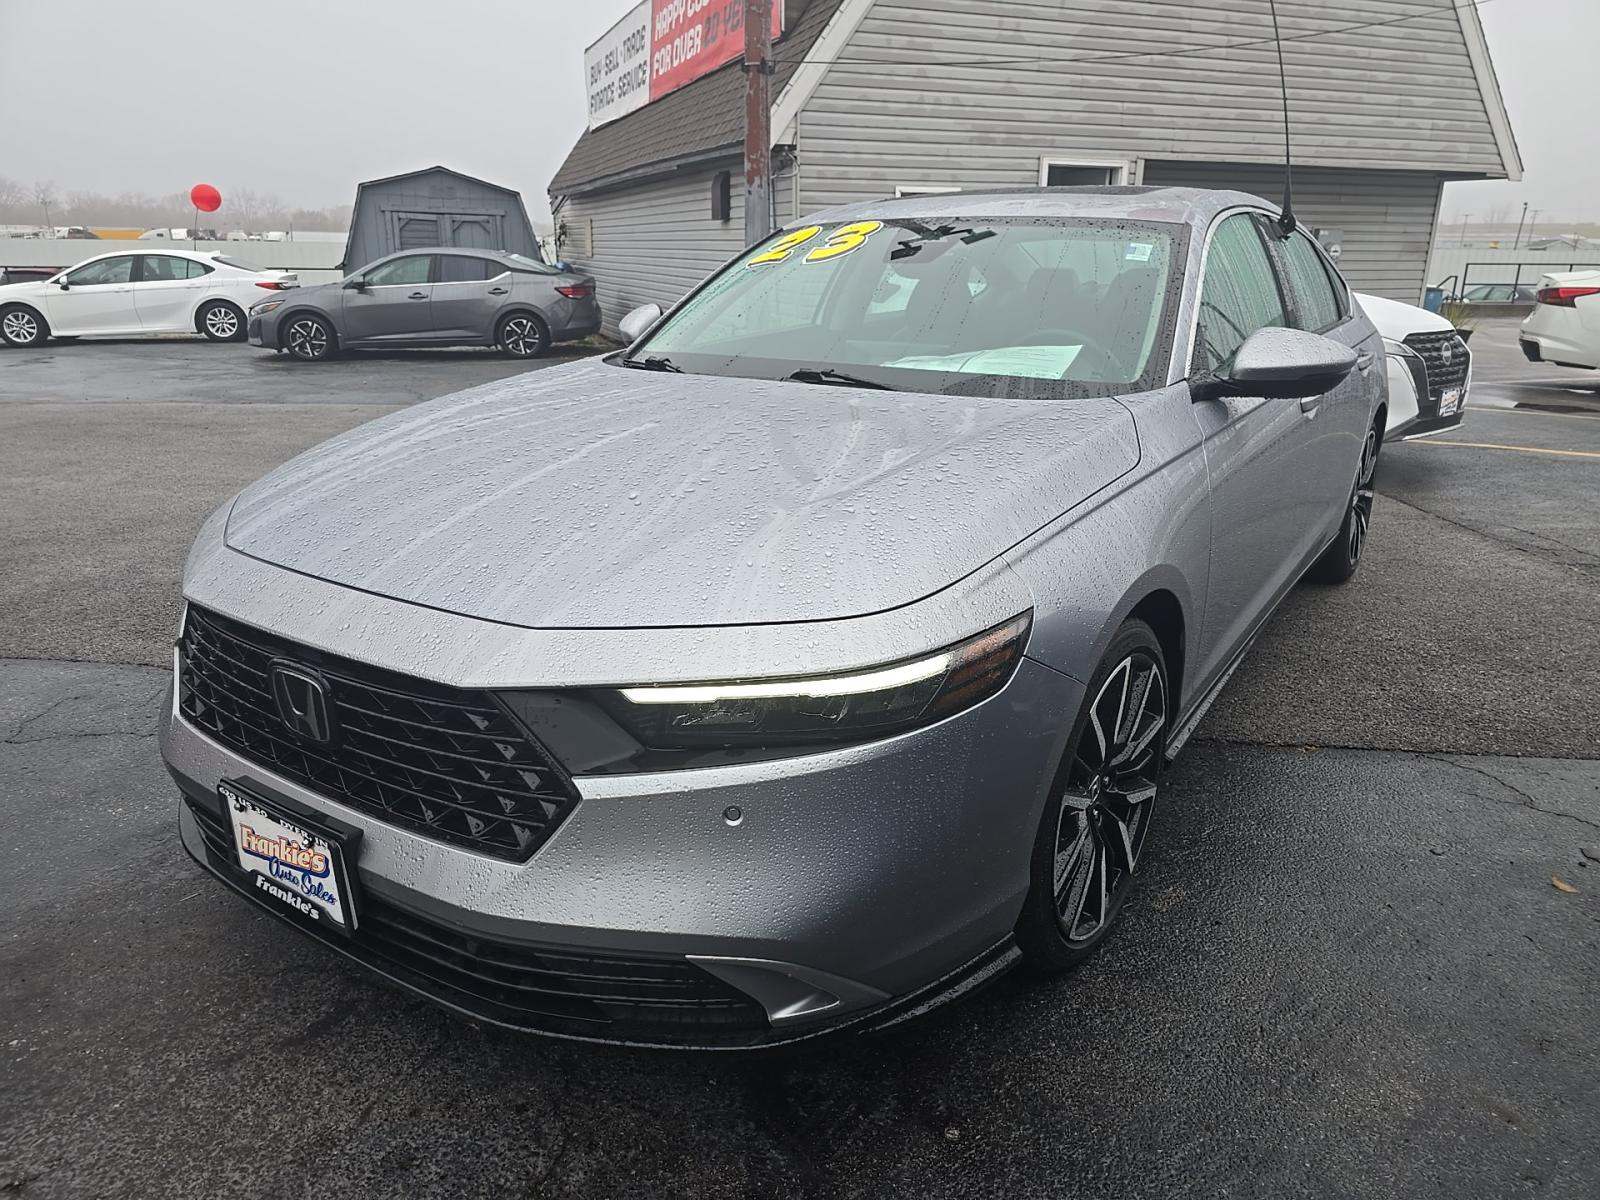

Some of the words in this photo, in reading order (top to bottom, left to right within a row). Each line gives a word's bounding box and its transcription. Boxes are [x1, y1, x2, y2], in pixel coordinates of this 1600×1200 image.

[590, 59, 602, 87] BUY
[604, 46, 619, 76] SELL
[622, 24, 646, 63] TRADE
[653, 44, 672, 79] FOR
[673, 24, 702, 67] OVER
[590, 81, 615, 115] FINANCE
[618, 59, 647, 99] SERVICE
[746, 220, 884, 268] 23
[240, 823, 327, 875] Frankie's
[315, 837, 329, 849] IN
[255, 875, 320, 920] Frankie's
[268, 857, 300, 887] Auto
[300, 873, 337, 906] Sales
